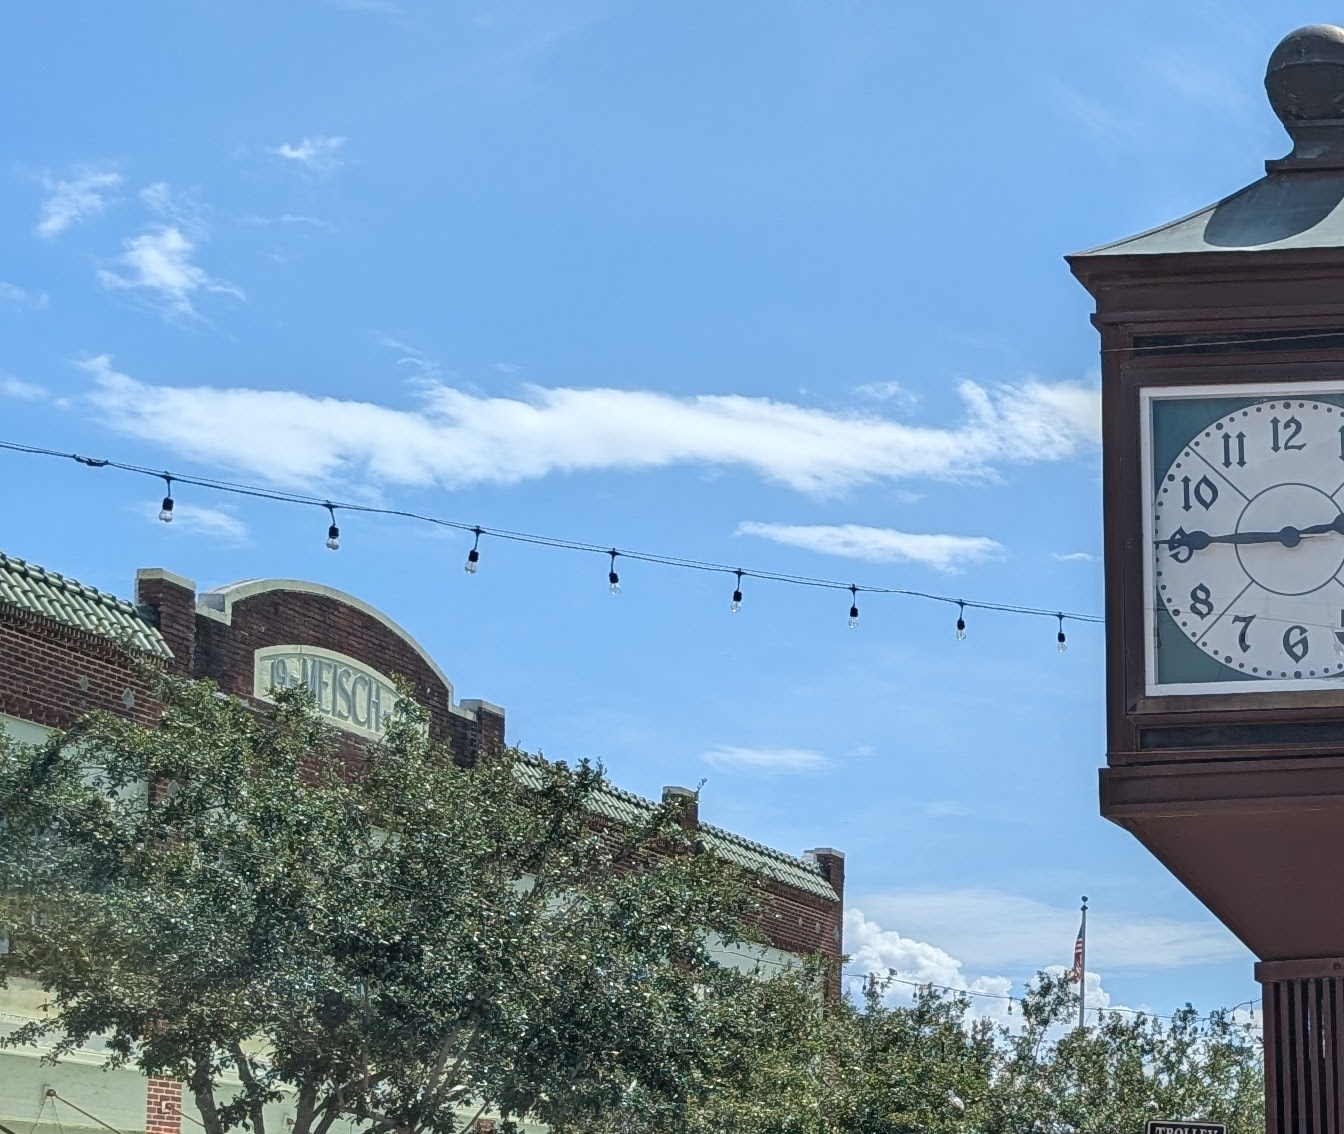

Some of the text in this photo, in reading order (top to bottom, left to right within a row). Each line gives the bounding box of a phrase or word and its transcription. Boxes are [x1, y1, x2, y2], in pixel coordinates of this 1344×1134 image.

[1221, 431, 1247, 469] 11
[1270, 415, 1307, 454] 12
[1181, 474, 1219, 512] 10
[1168, 526, 1194, 564] 9
[1189, 582, 1215, 620] 8
[1231, 614, 1258, 654] 7
[1282, 624, 1309, 664] 6
